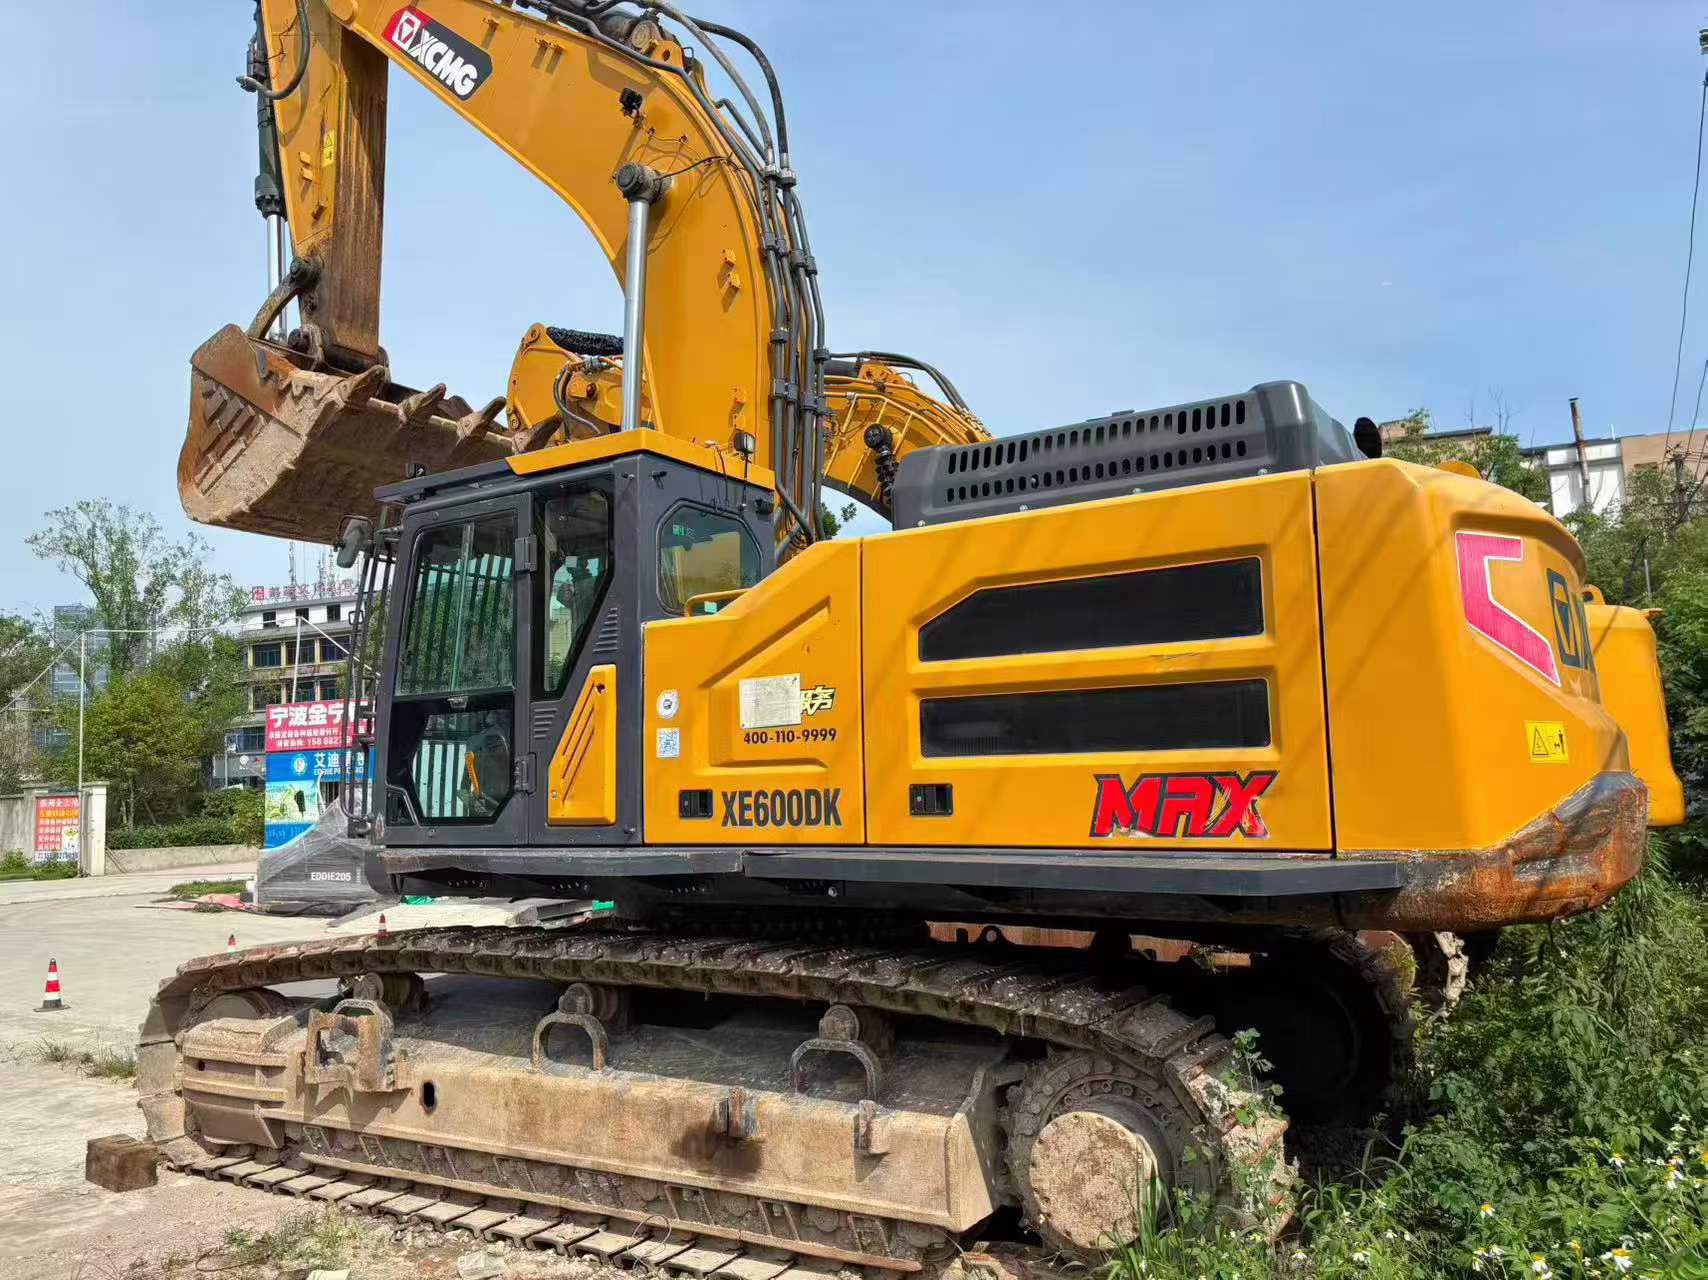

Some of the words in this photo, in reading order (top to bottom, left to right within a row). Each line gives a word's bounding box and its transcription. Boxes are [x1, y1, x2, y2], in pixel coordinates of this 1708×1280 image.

[407, 28, 478, 96] XCMG
[743, 728, 837, 744] 400-110-9999
[721, 788, 842, 828] XE600DK
[1090, 771, 1278, 839] MAX
[310, 871, 351, 882] EDDIE205
